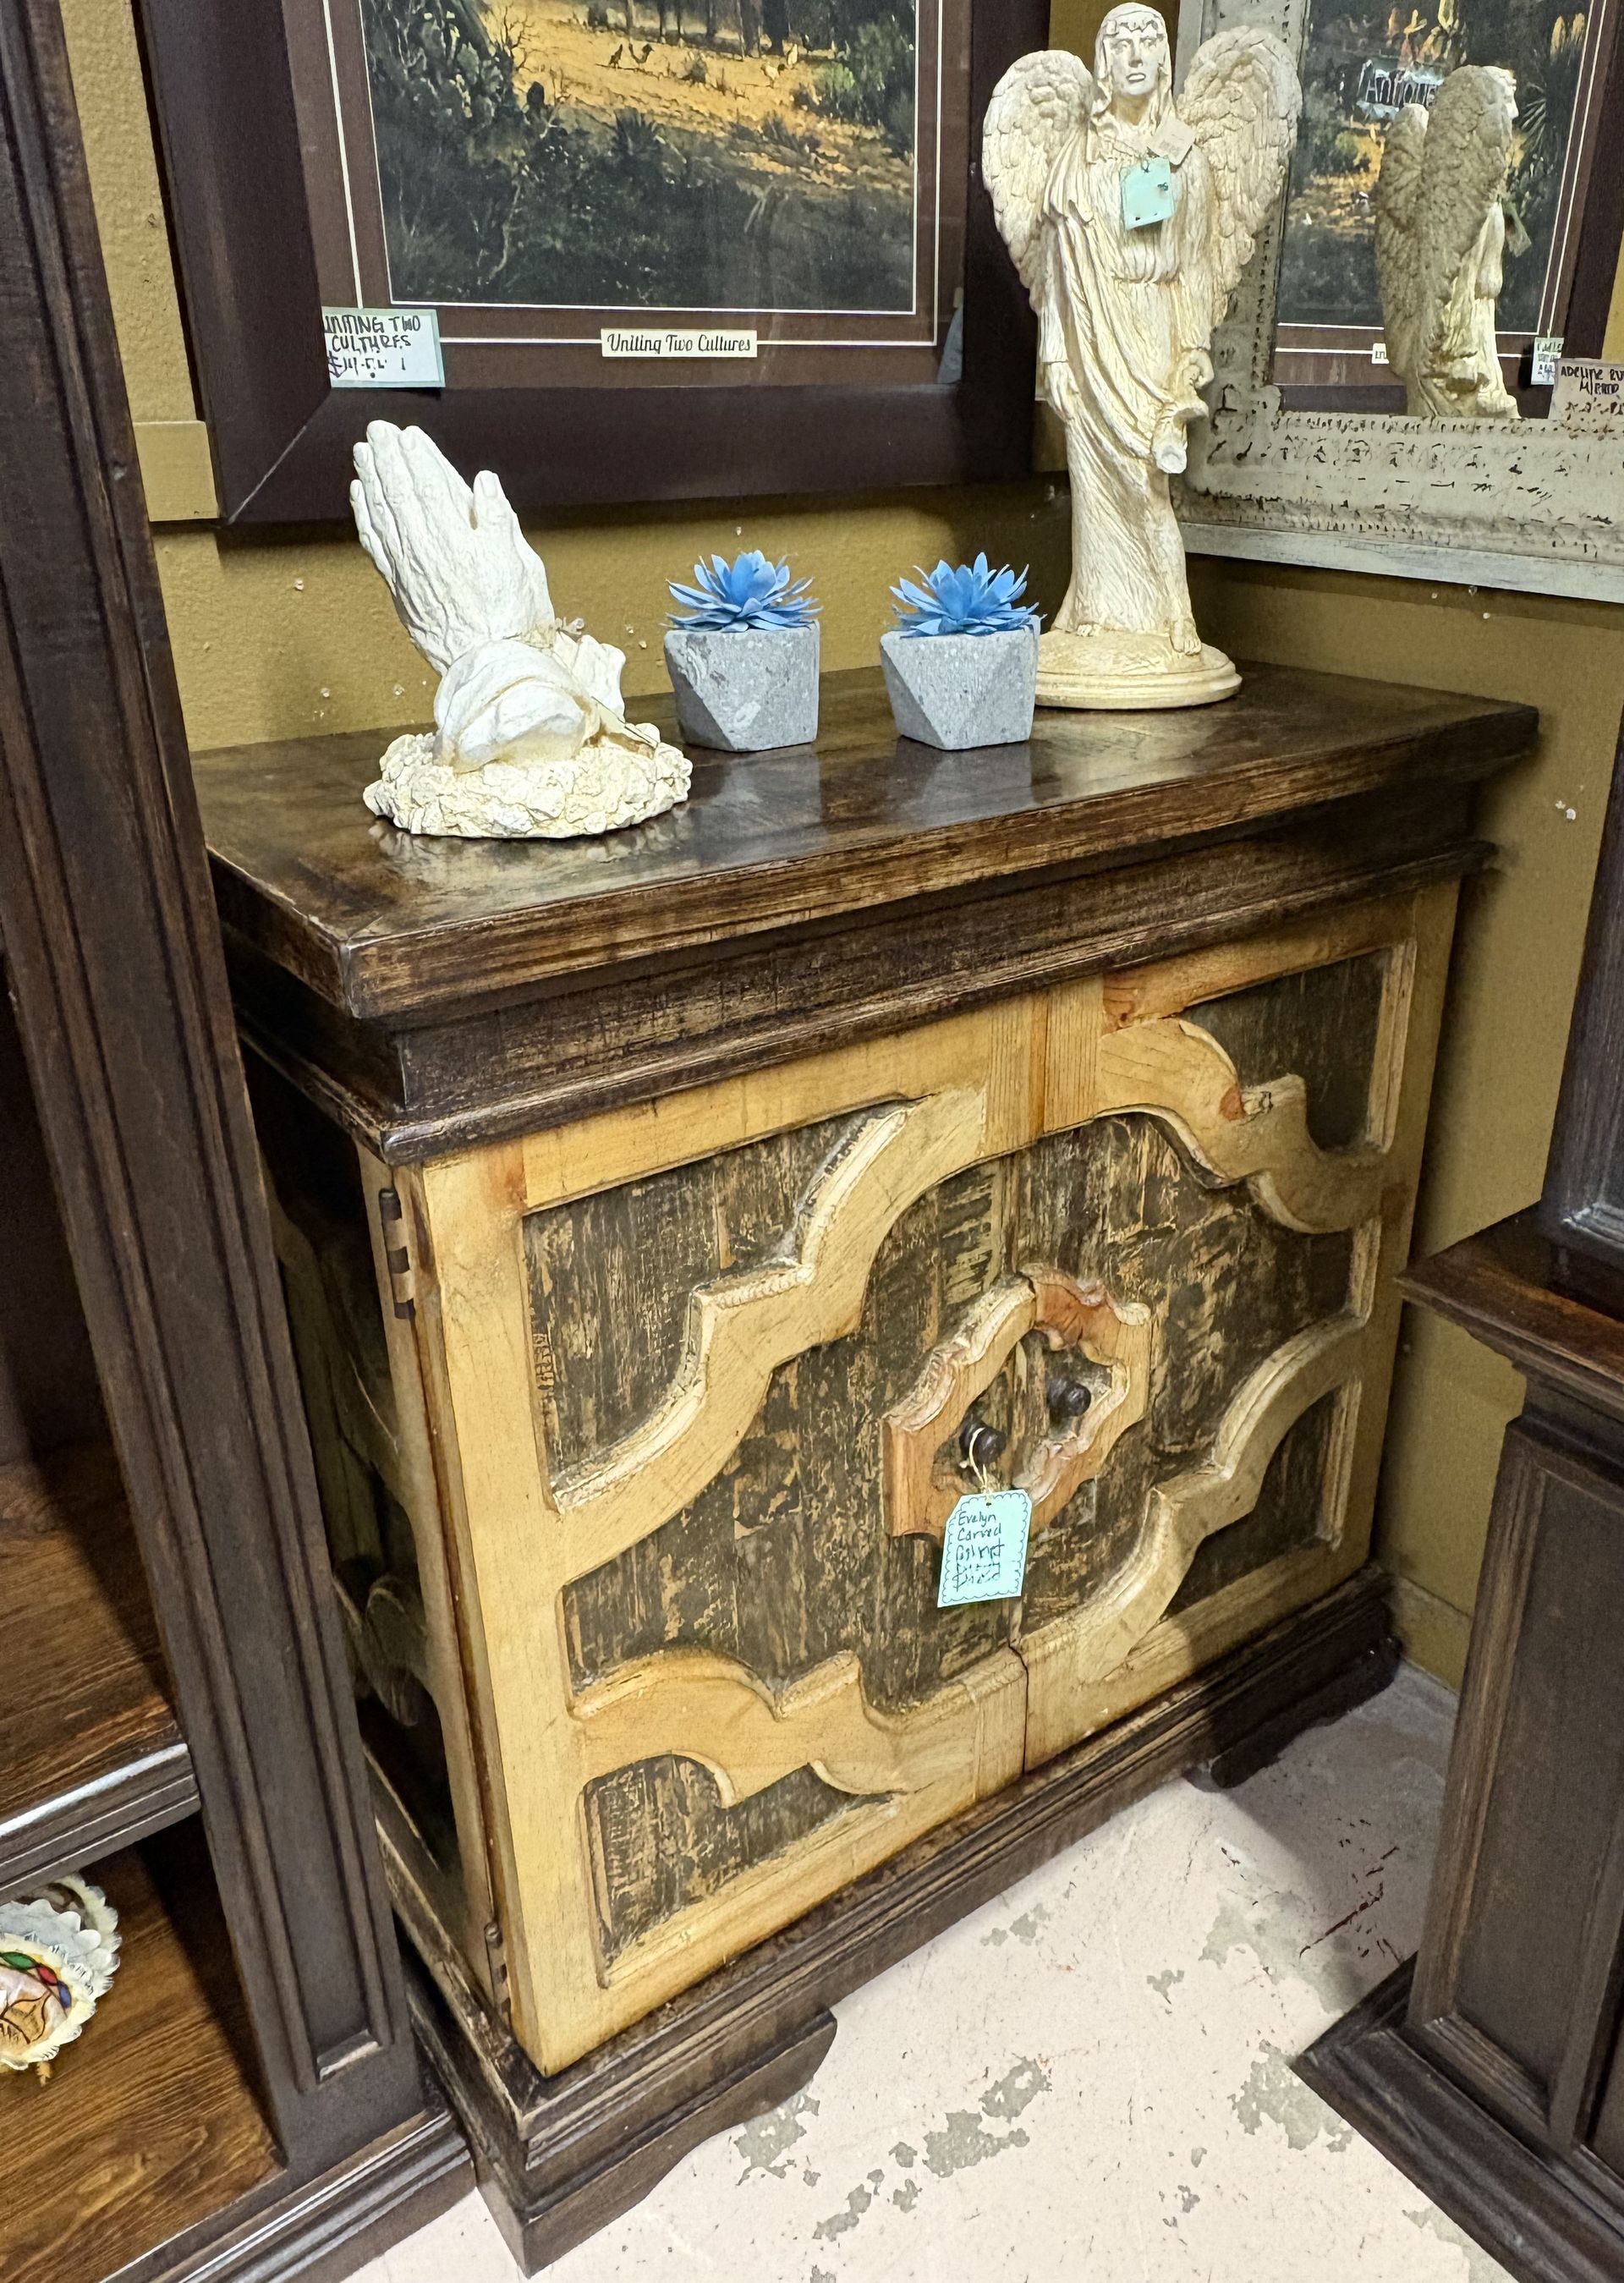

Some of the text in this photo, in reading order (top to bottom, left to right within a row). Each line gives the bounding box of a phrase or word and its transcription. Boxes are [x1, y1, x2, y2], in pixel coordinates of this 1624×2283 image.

[666, 334, 693, 352] Two
[698, 334, 750, 352] Cultures
[957, 1511, 996, 1528] Evelyn
[957, 1523, 1001, 1541] Carved
